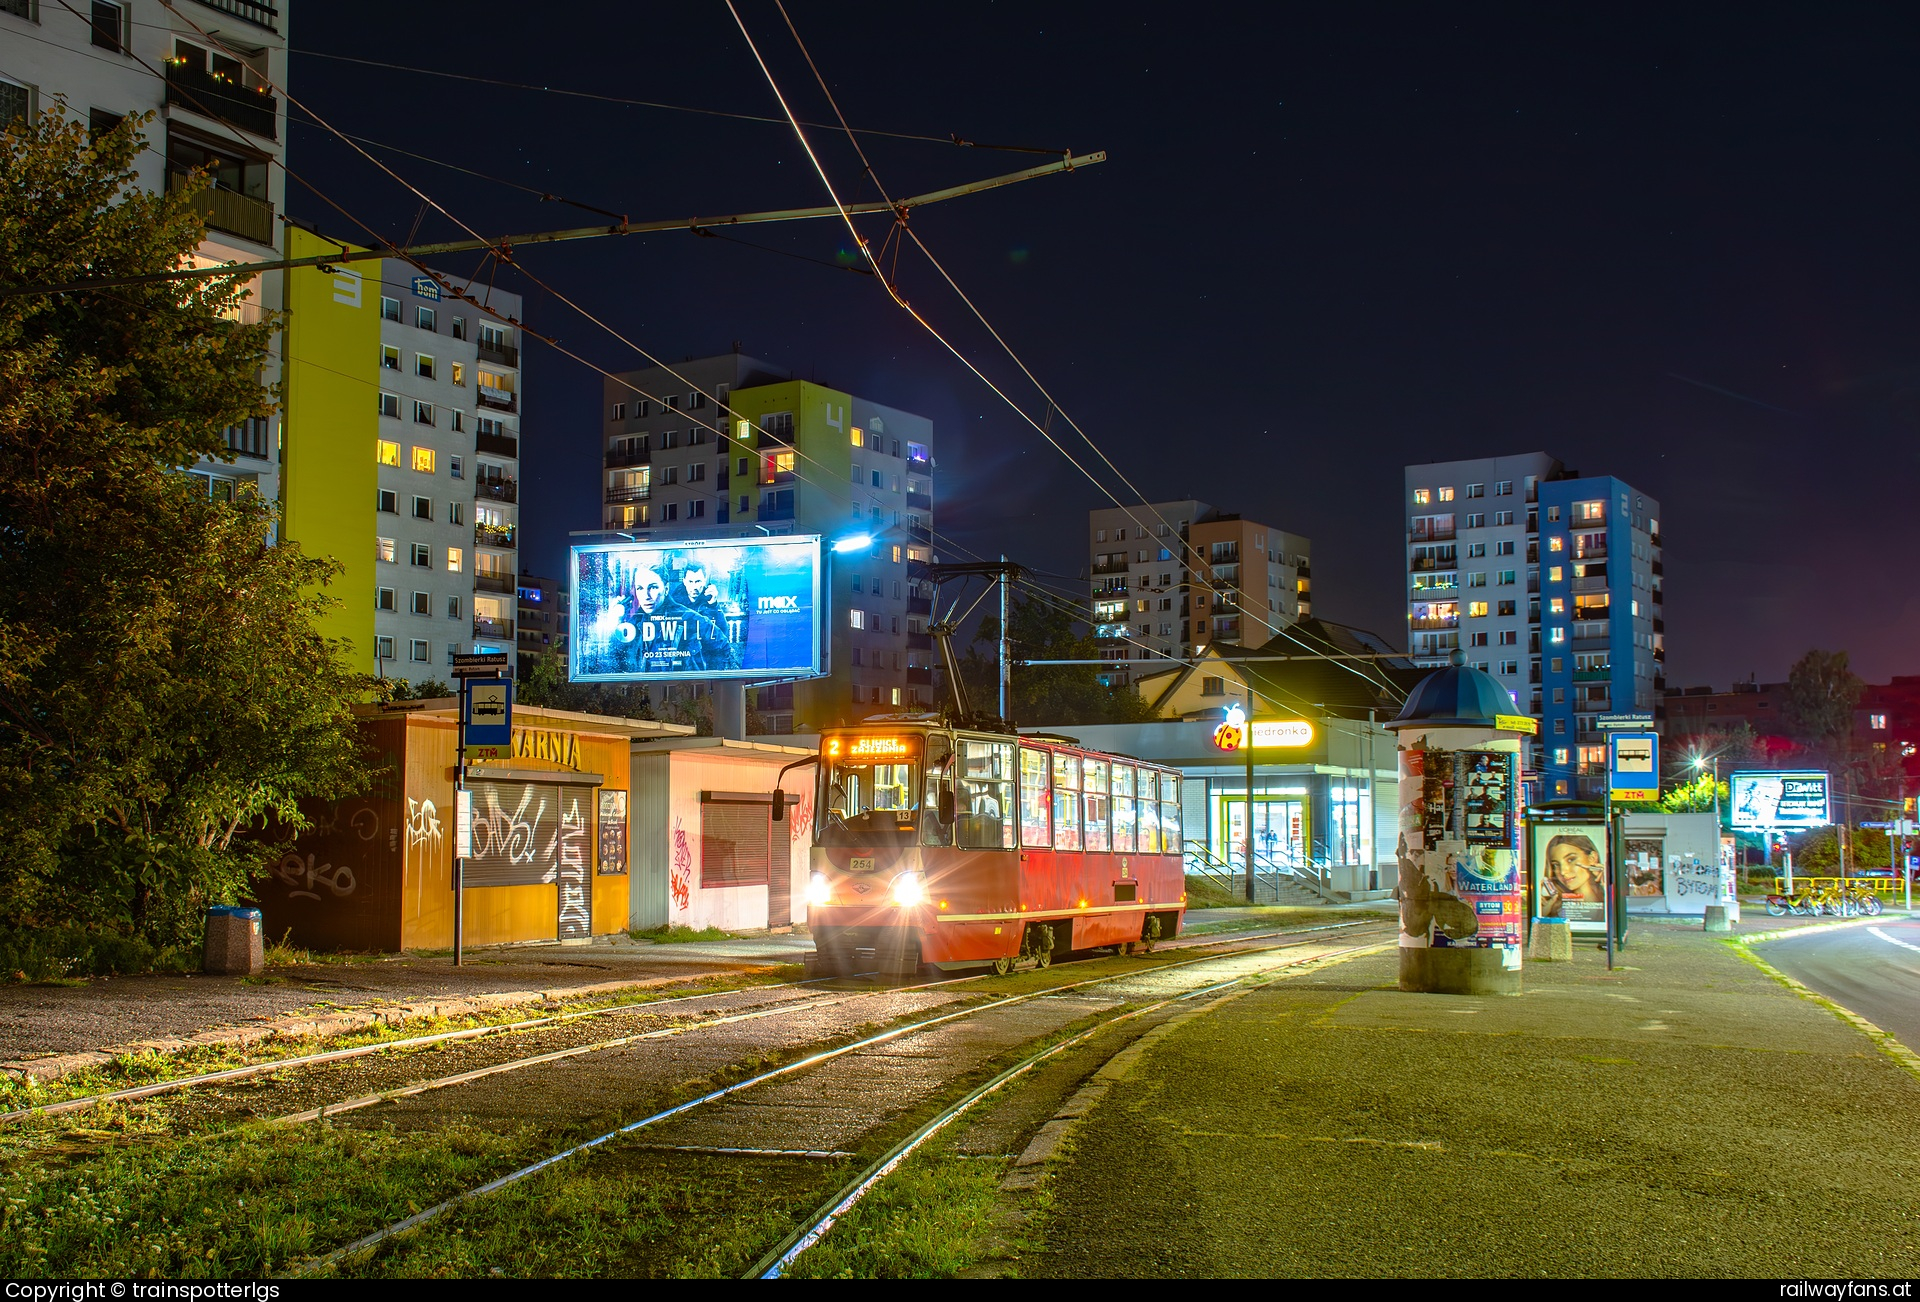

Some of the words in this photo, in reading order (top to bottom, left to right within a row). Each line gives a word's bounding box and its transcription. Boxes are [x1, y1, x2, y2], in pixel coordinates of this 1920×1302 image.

[333, 264, 362, 309] 3
[417, 278, 438, 300] bsm
[826, 402, 843, 433] 4
[1255, 533, 1265, 554] 4
[758, 595, 798, 609] max
[615, 617, 716, 643] ODWILŻ
[663, 650, 691, 658] SIERPNIA
[454, 656, 486, 664] Szombierki
[1253, 726, 1308, 736] iedronka
[478, 747, 498, 757] ZTM
[829, 740, 839, 755] 2
[851, 745, 906, 754] ZAJEZDNIA
[1624, 791, 1644, 799] ZTM
[900, 812, 909, 820] 13
[852, 860, 872, 869] 254
